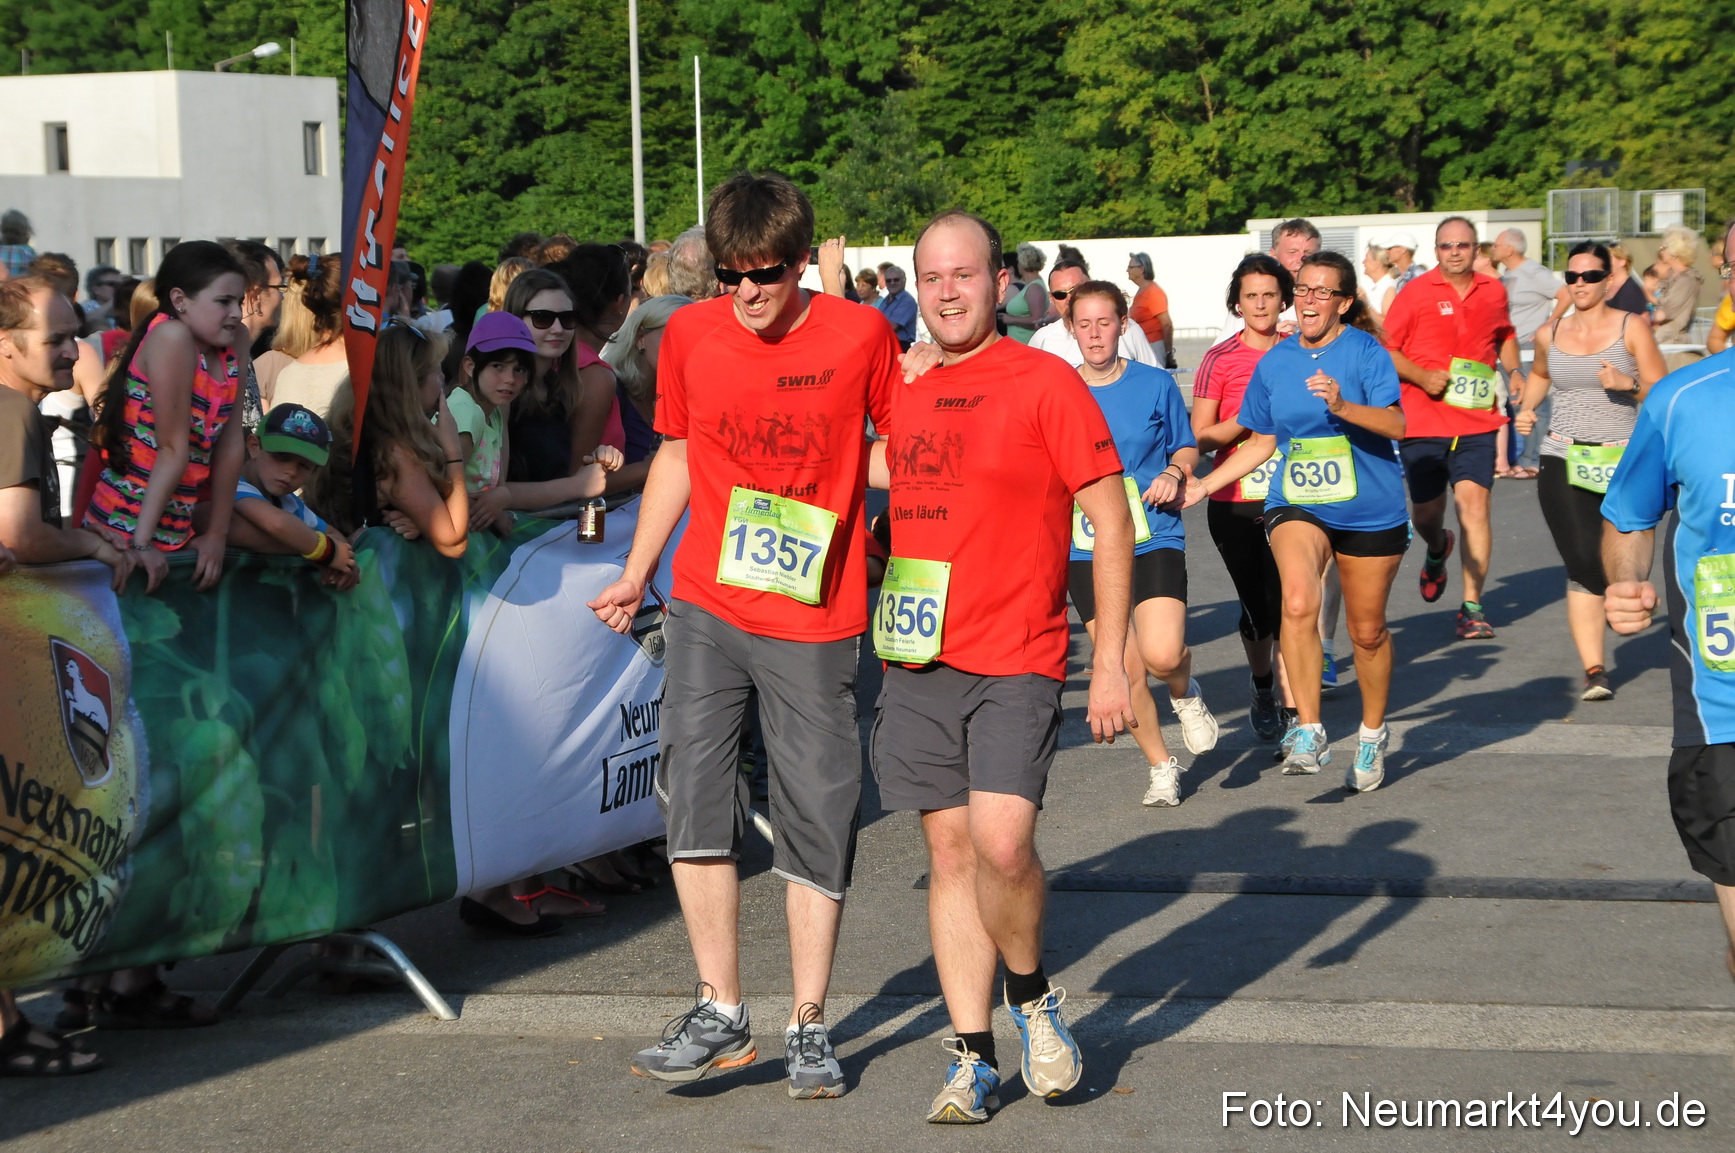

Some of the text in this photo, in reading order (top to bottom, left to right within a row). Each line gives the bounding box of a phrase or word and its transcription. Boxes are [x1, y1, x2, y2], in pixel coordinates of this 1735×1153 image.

[776, 374, 817, 388] swn
[1454, 376, 1490, 398] 813
[934, 397, 968, 409] swn
[1290, 460, 1342, 488] 630
[1577, 465, 1615, 484] 839
[780, 482, 819, 498] läuft
[893, 504, 948, 521] lles läuft
[728, 523, 822, 578] 1357
[878, 592, 939, 638] 1356
